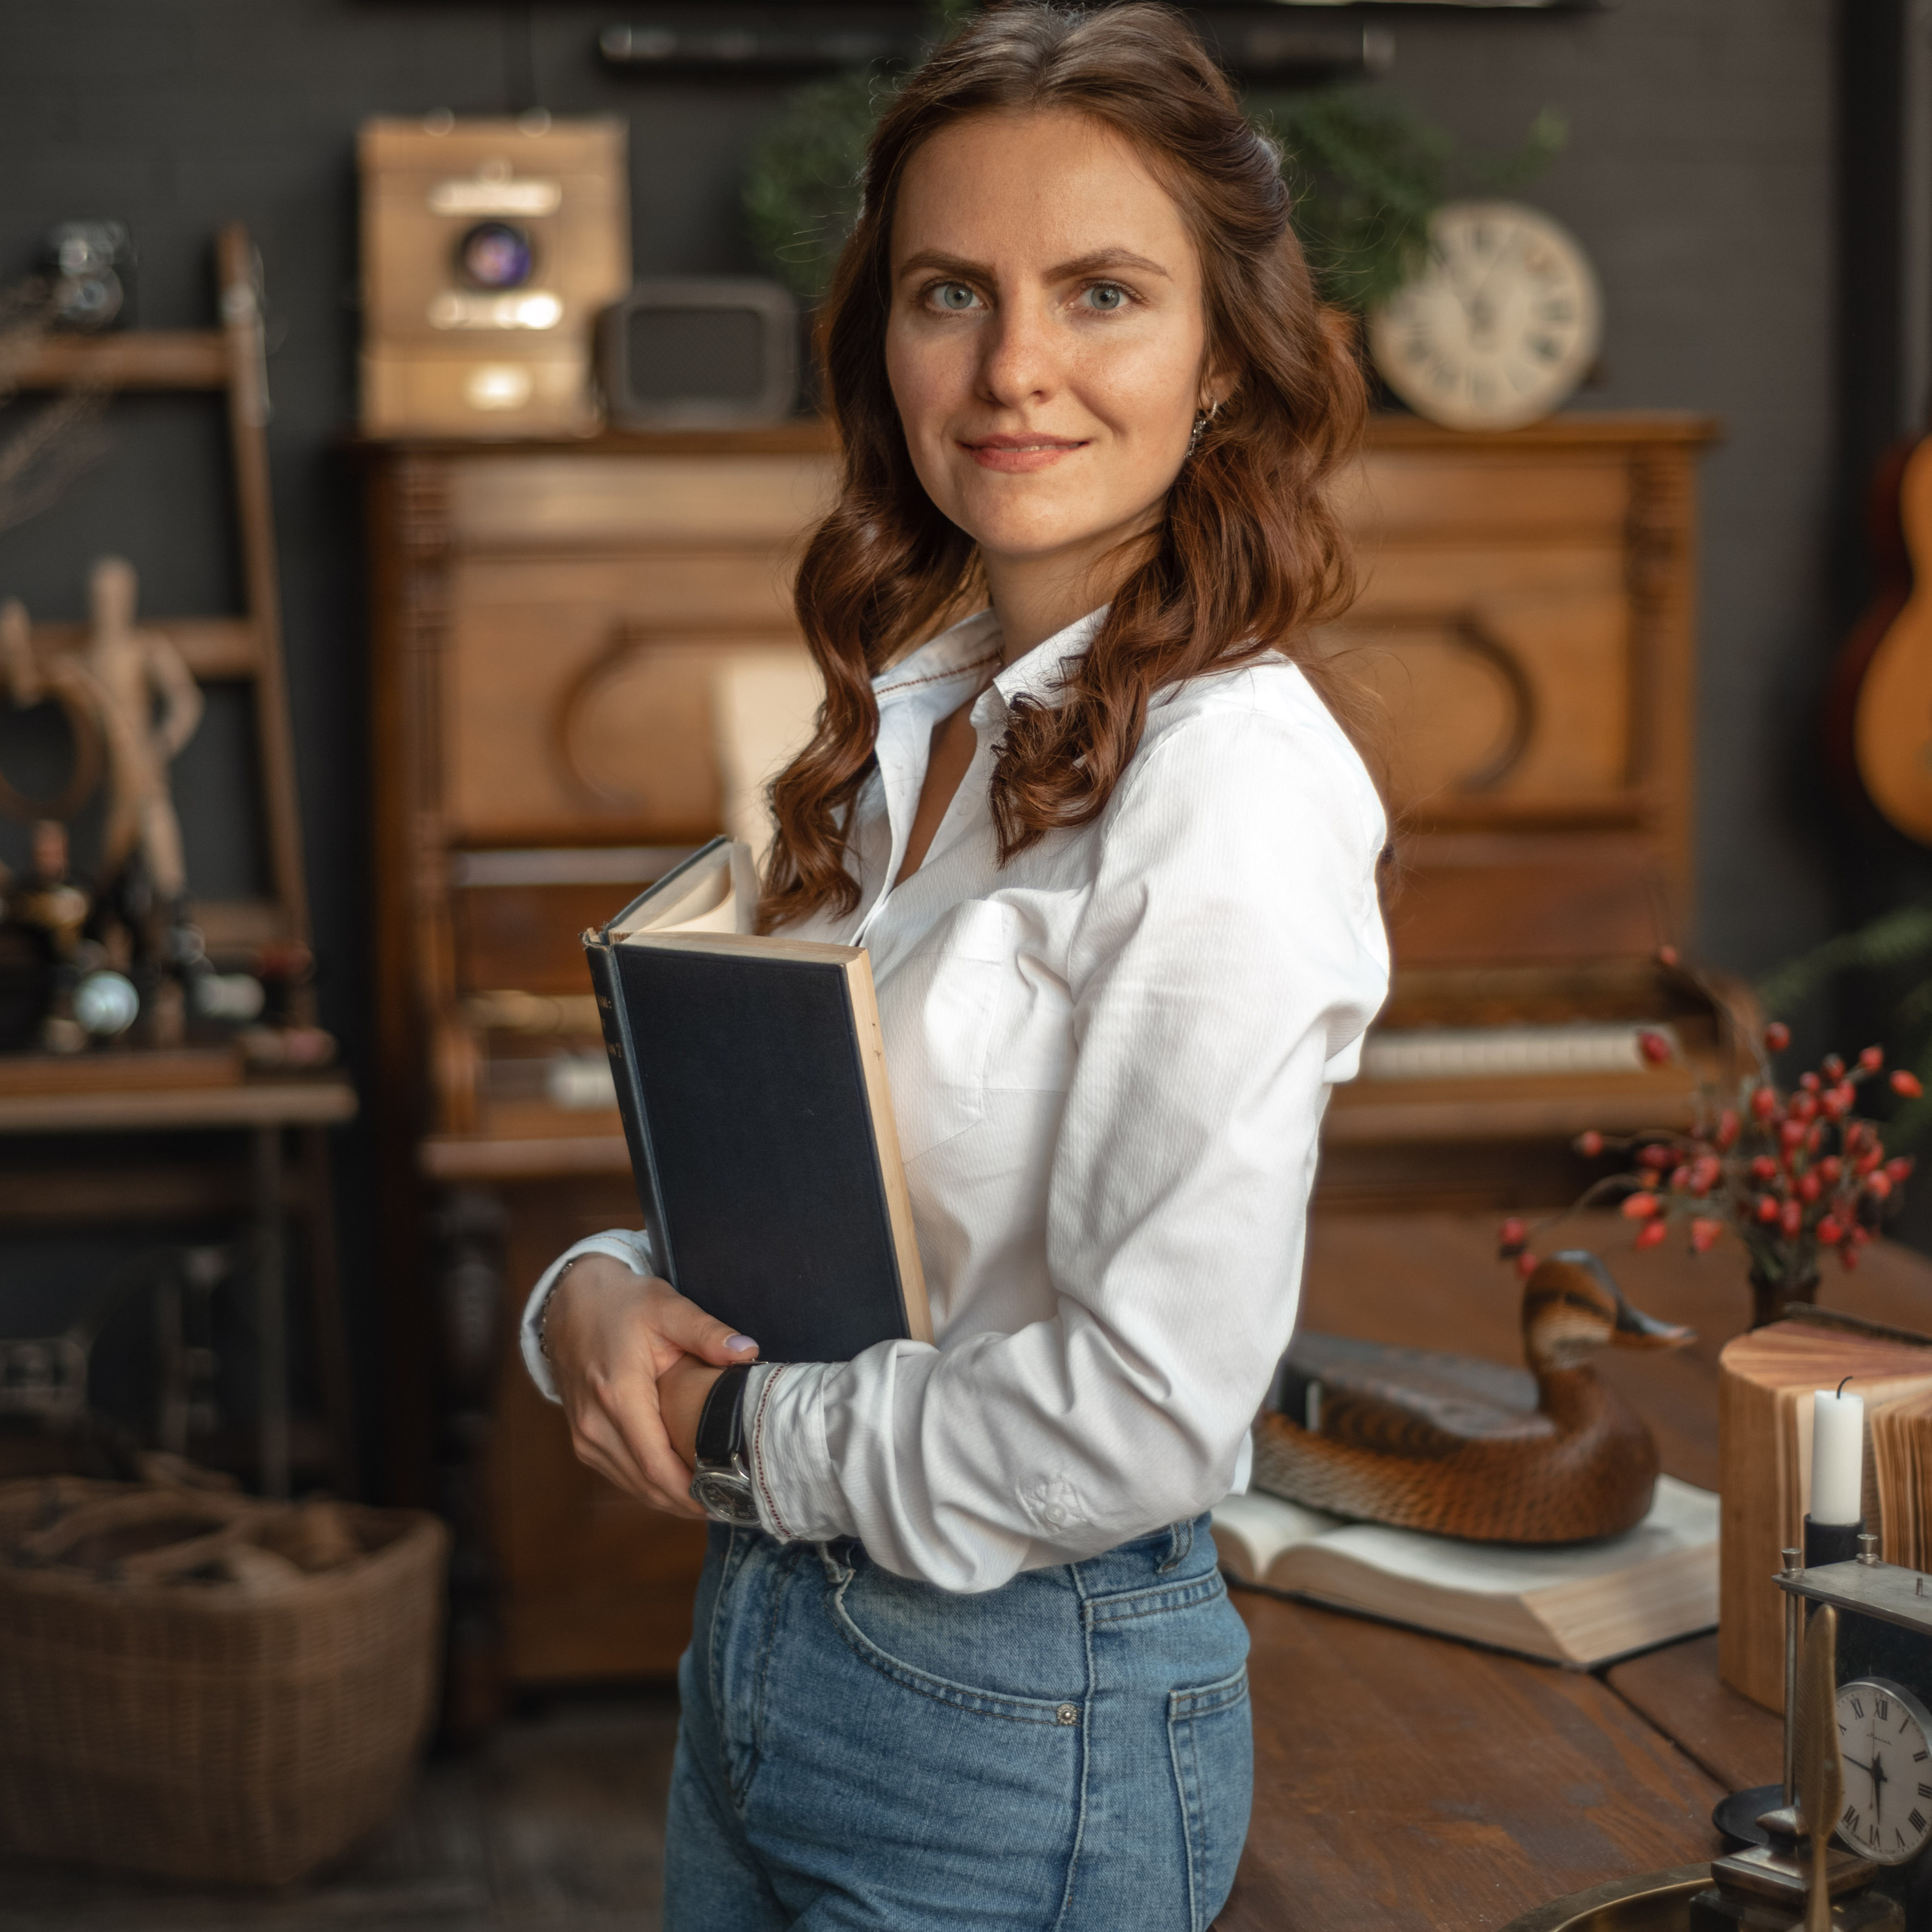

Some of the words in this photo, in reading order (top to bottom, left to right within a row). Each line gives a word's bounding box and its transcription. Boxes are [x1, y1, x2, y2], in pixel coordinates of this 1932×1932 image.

[1850, 1698, 1864, 1720] XI
[1873, 1697, 1887, 1721] XII
[1899, 1718, 1909, 1734] I
[1912, 1750, 1928, 1763] II
[1869, 1824, 1881, 1847] VI
[1895, 1827, 1906, 1848] V
